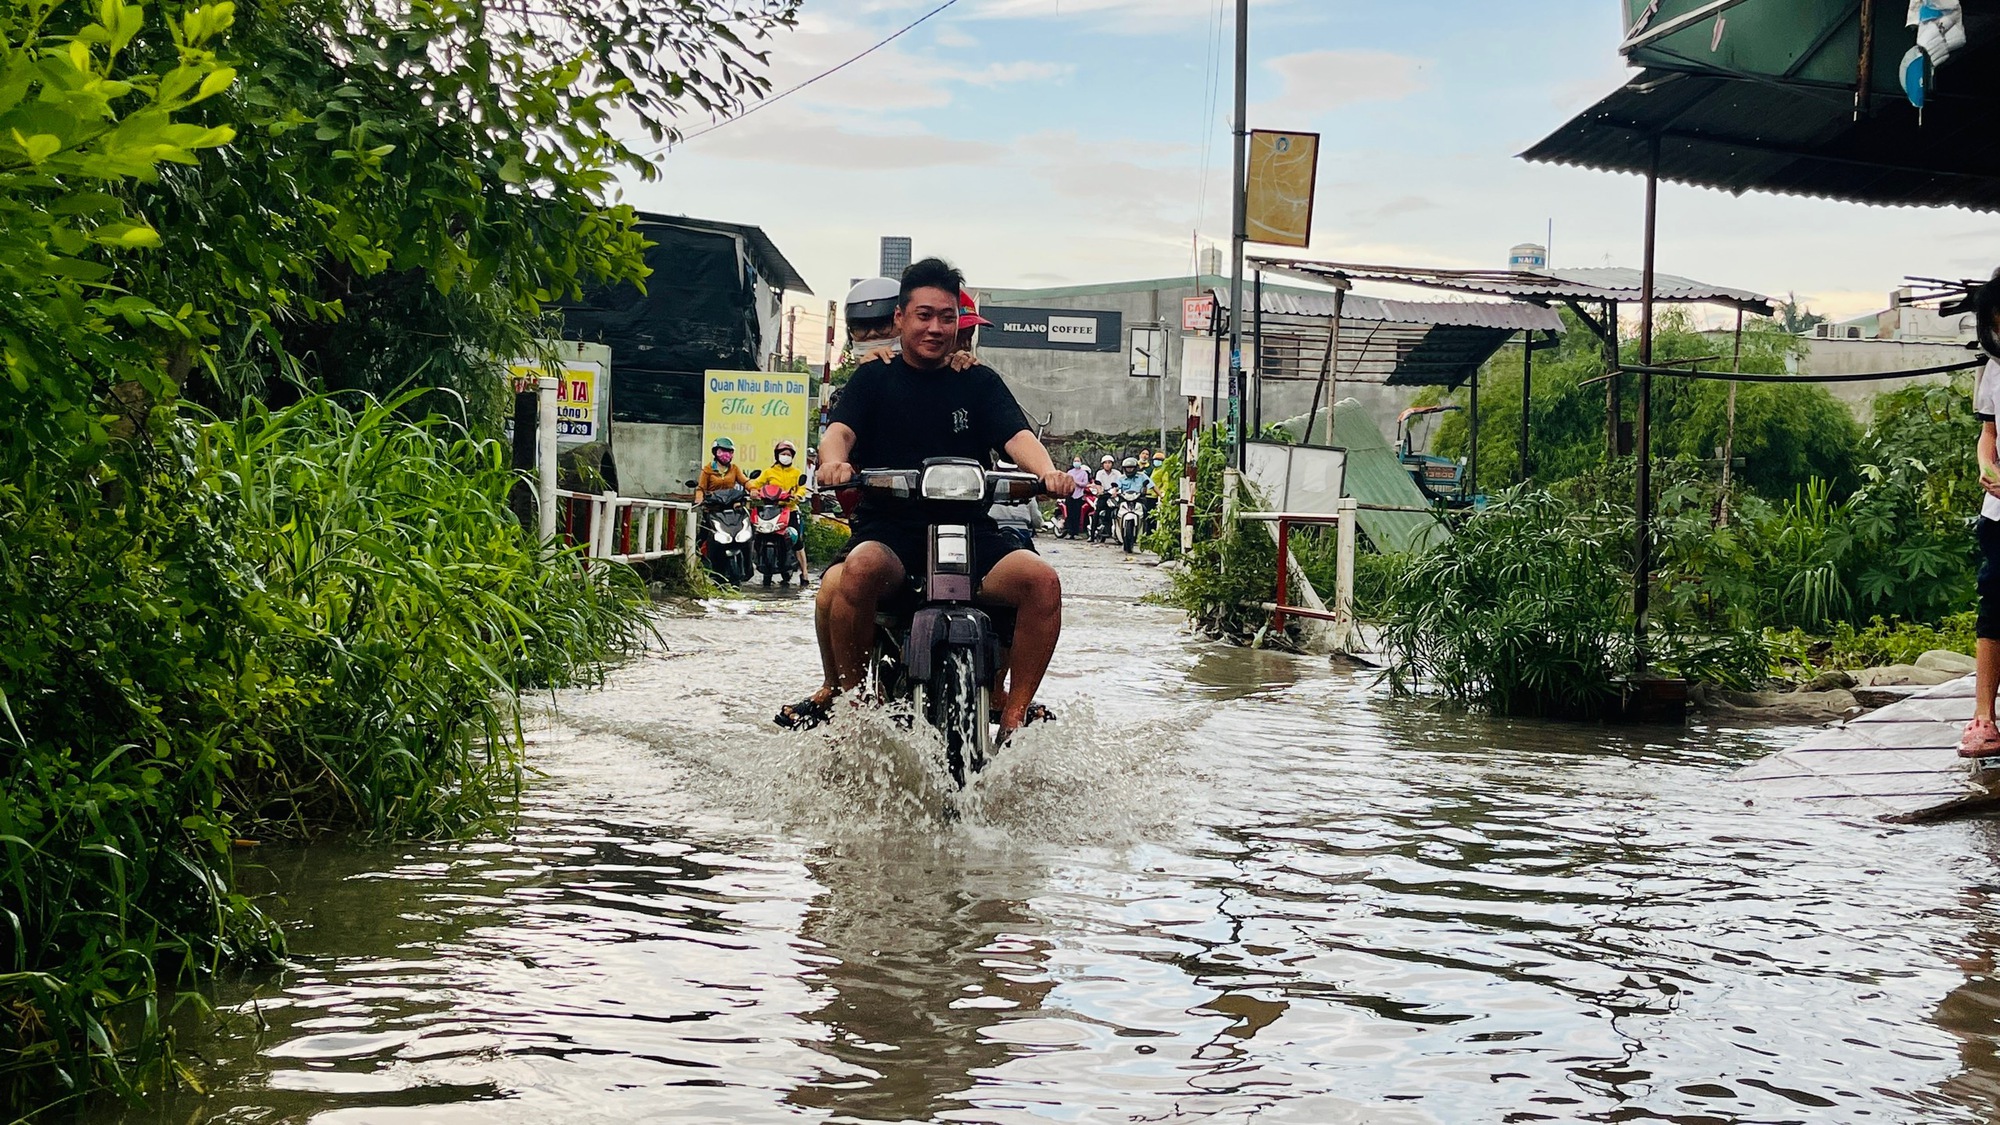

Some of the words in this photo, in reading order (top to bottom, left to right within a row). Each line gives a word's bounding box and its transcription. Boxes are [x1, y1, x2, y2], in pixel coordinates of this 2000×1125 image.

[1003, 322, 1047, 333] MILANO
[1051, 325, 1093, 334] COFFEE
[571, 381, 587, 401] TA
[721, 398, 754, 415] Thu
[761, 400, 789, 416] Hà
